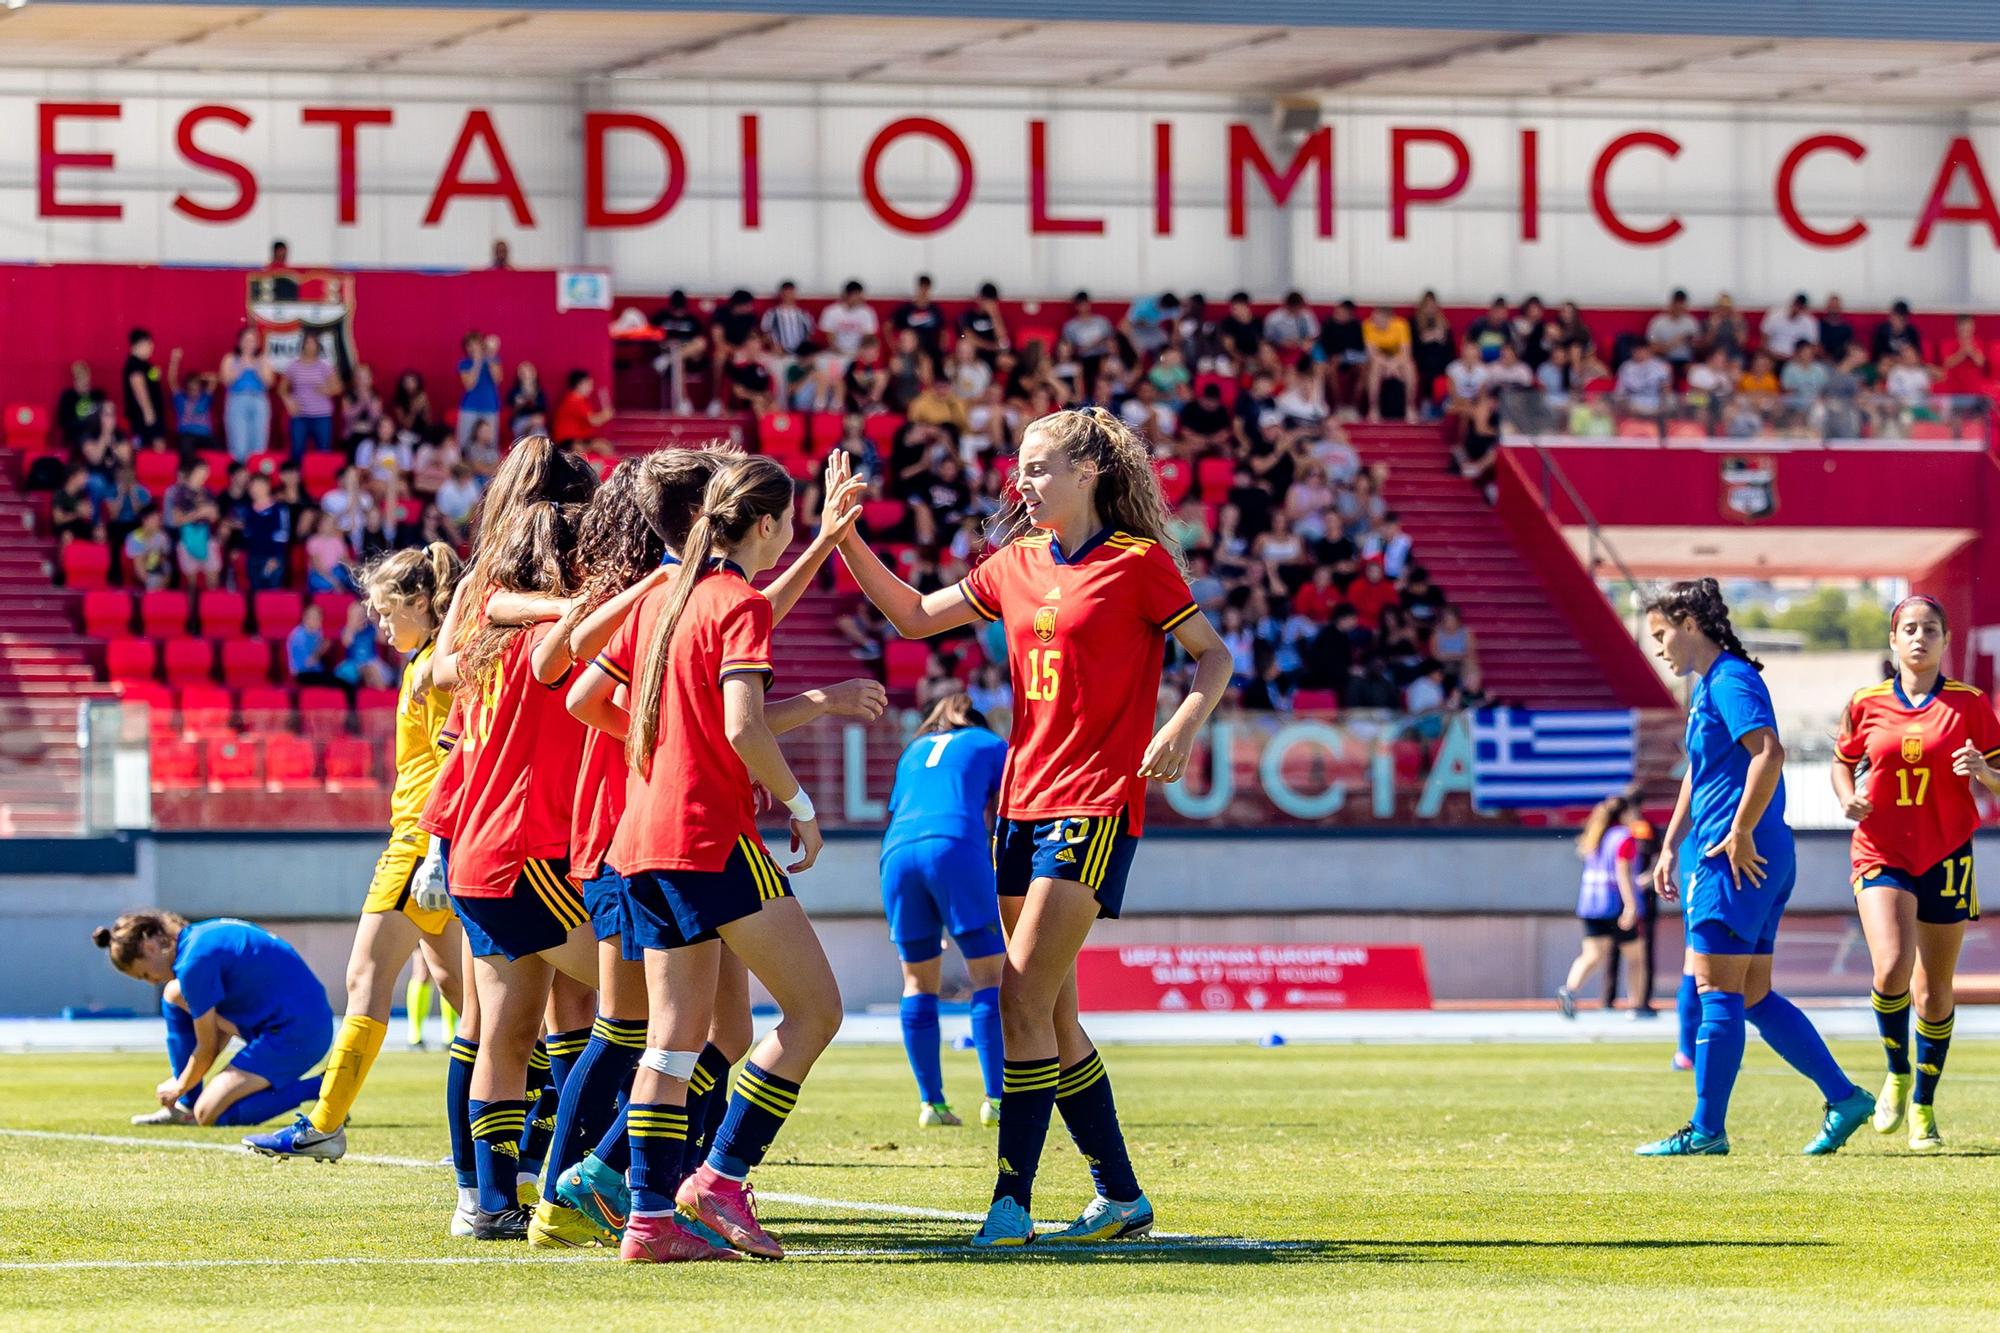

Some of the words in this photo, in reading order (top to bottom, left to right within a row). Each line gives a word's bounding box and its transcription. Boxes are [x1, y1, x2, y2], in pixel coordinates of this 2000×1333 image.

[37, 102, 760, 230] ESTADI
[861, 116, 1683, 246] OLIMPIC
[1026, 648, 1061, 701] 15
[1895, 767, 1931, 806] 17
[1940, 855, 1973, 897] 17
